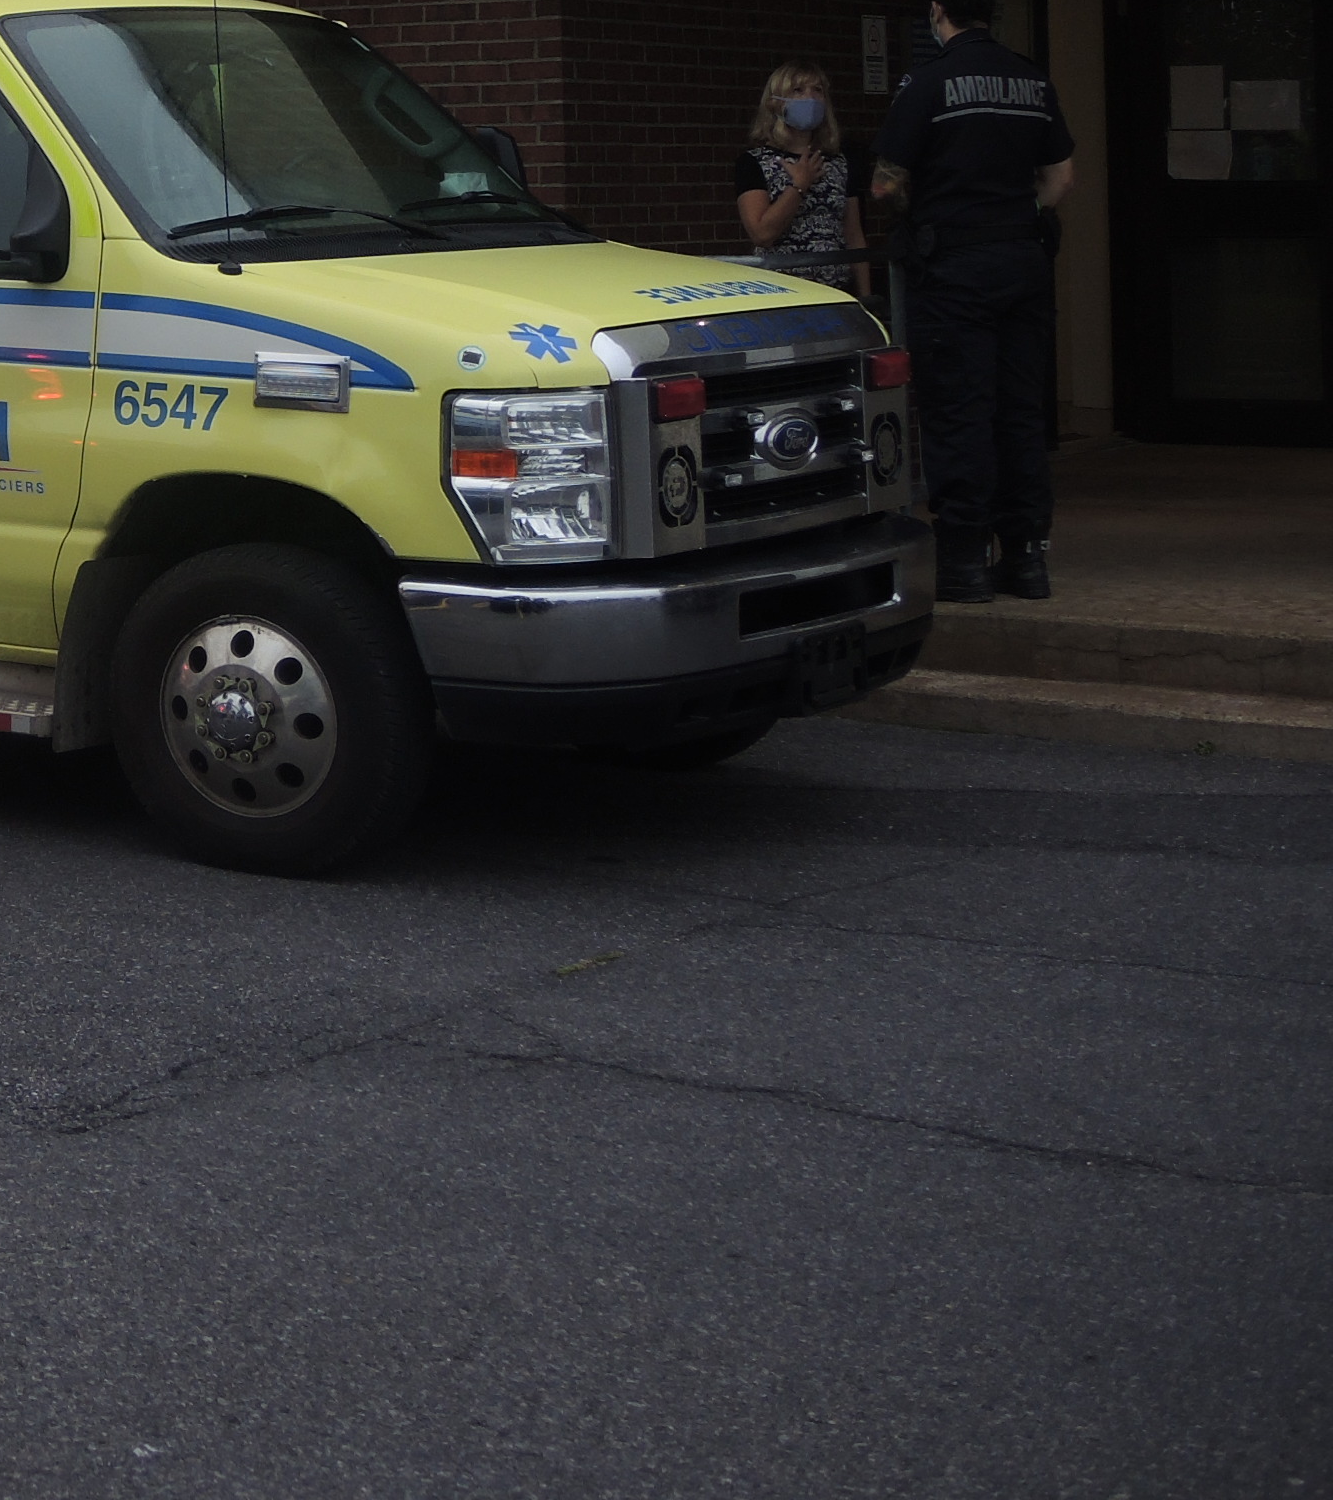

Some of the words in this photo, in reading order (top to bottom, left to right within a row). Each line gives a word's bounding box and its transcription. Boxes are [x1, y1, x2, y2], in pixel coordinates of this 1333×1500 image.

[944, 75, 1047, 108] AMBULANCE
[114, 379, 229, 431] 6547
[785, 426, 812, 451] Ford
